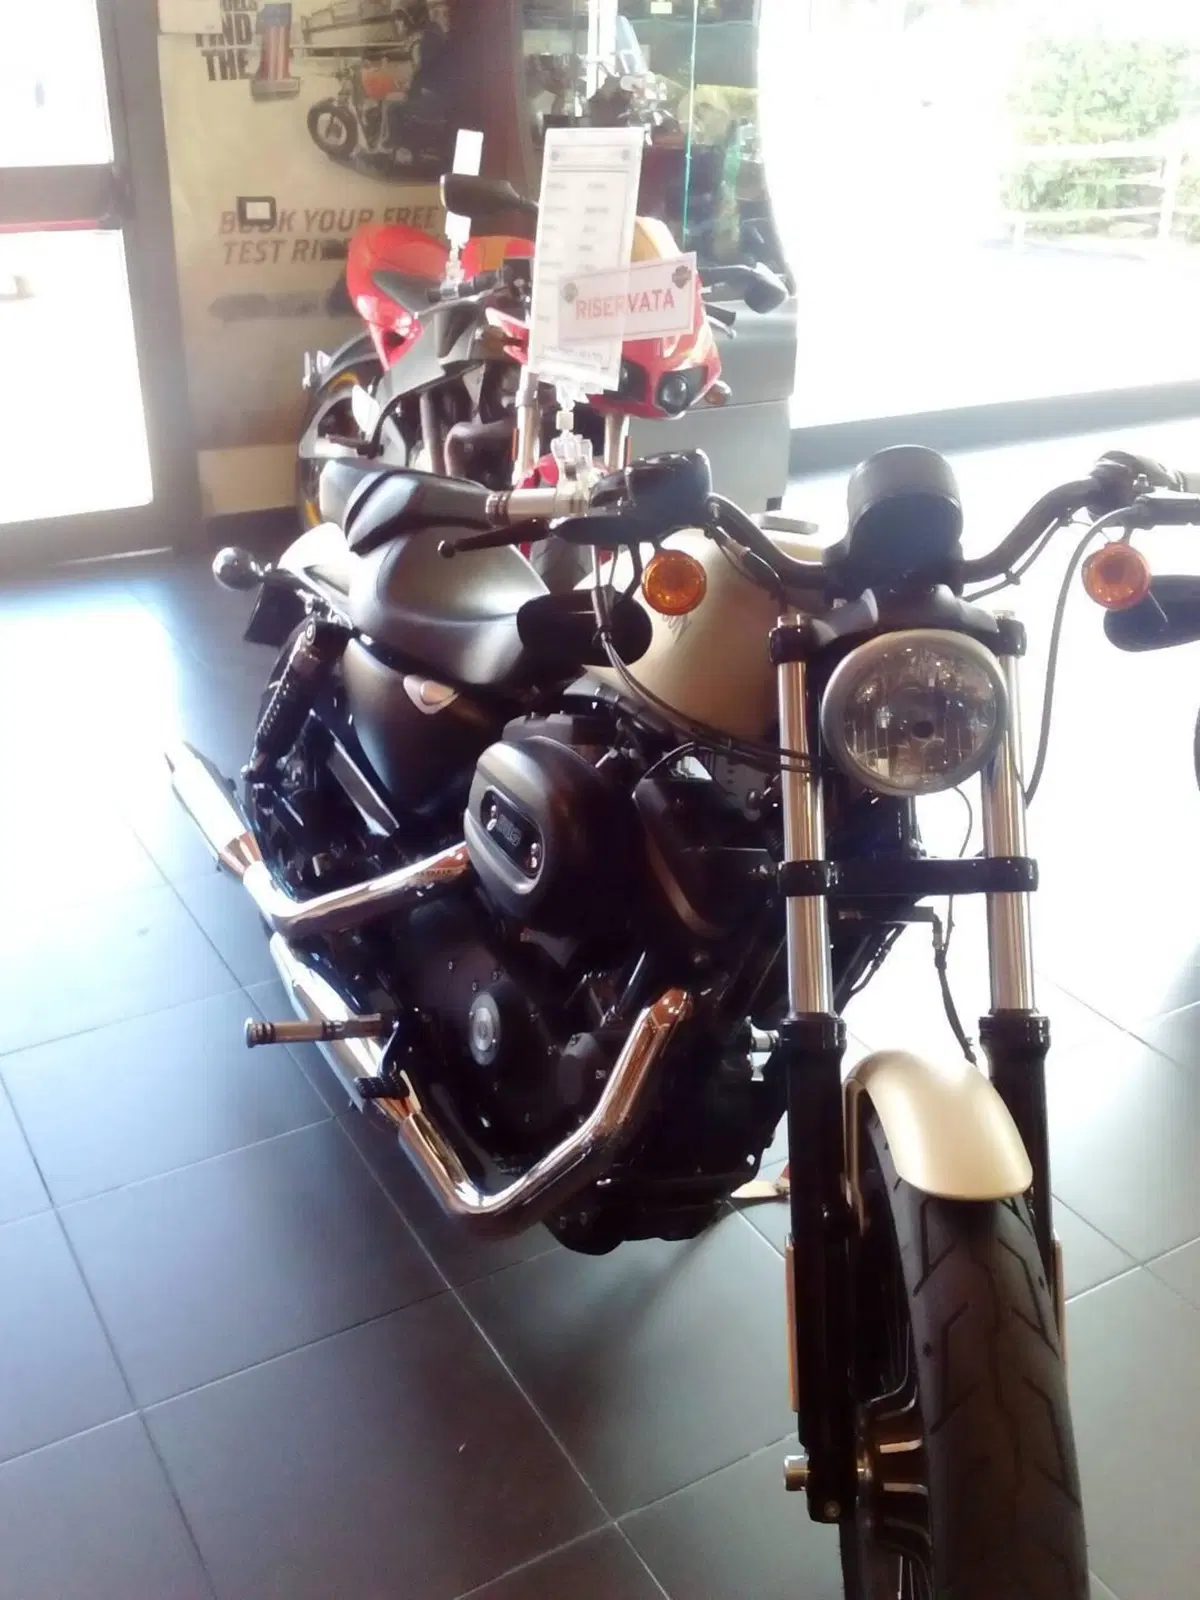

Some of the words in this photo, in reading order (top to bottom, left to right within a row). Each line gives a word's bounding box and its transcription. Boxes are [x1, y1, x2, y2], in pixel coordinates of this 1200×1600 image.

[201, 48, 257, 81] THE
[223, 239, 288, 265] TEST
[290, 237, 352, 264] RI
[575, 287, 676, 320] RISERVATA
